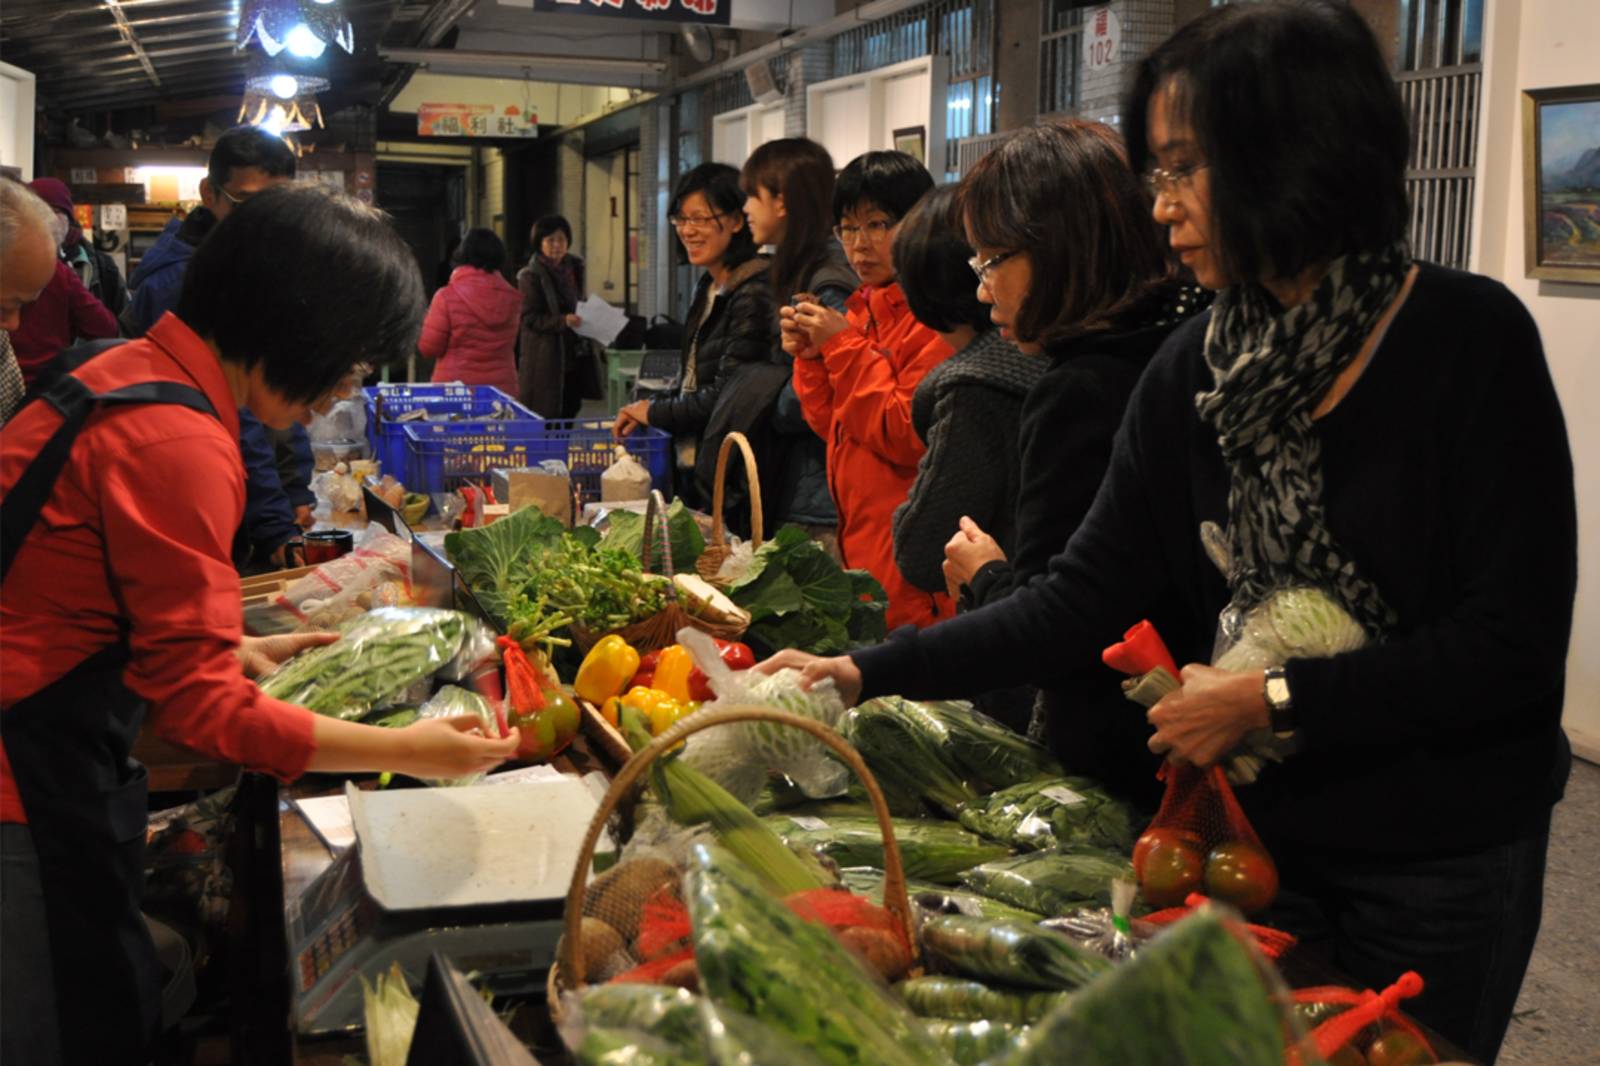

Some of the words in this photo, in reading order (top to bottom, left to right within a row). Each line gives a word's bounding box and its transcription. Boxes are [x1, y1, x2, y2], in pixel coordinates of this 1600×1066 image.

[1090, 39, 1112, 67] 102
[442, 116, 514, 134] 福利社
